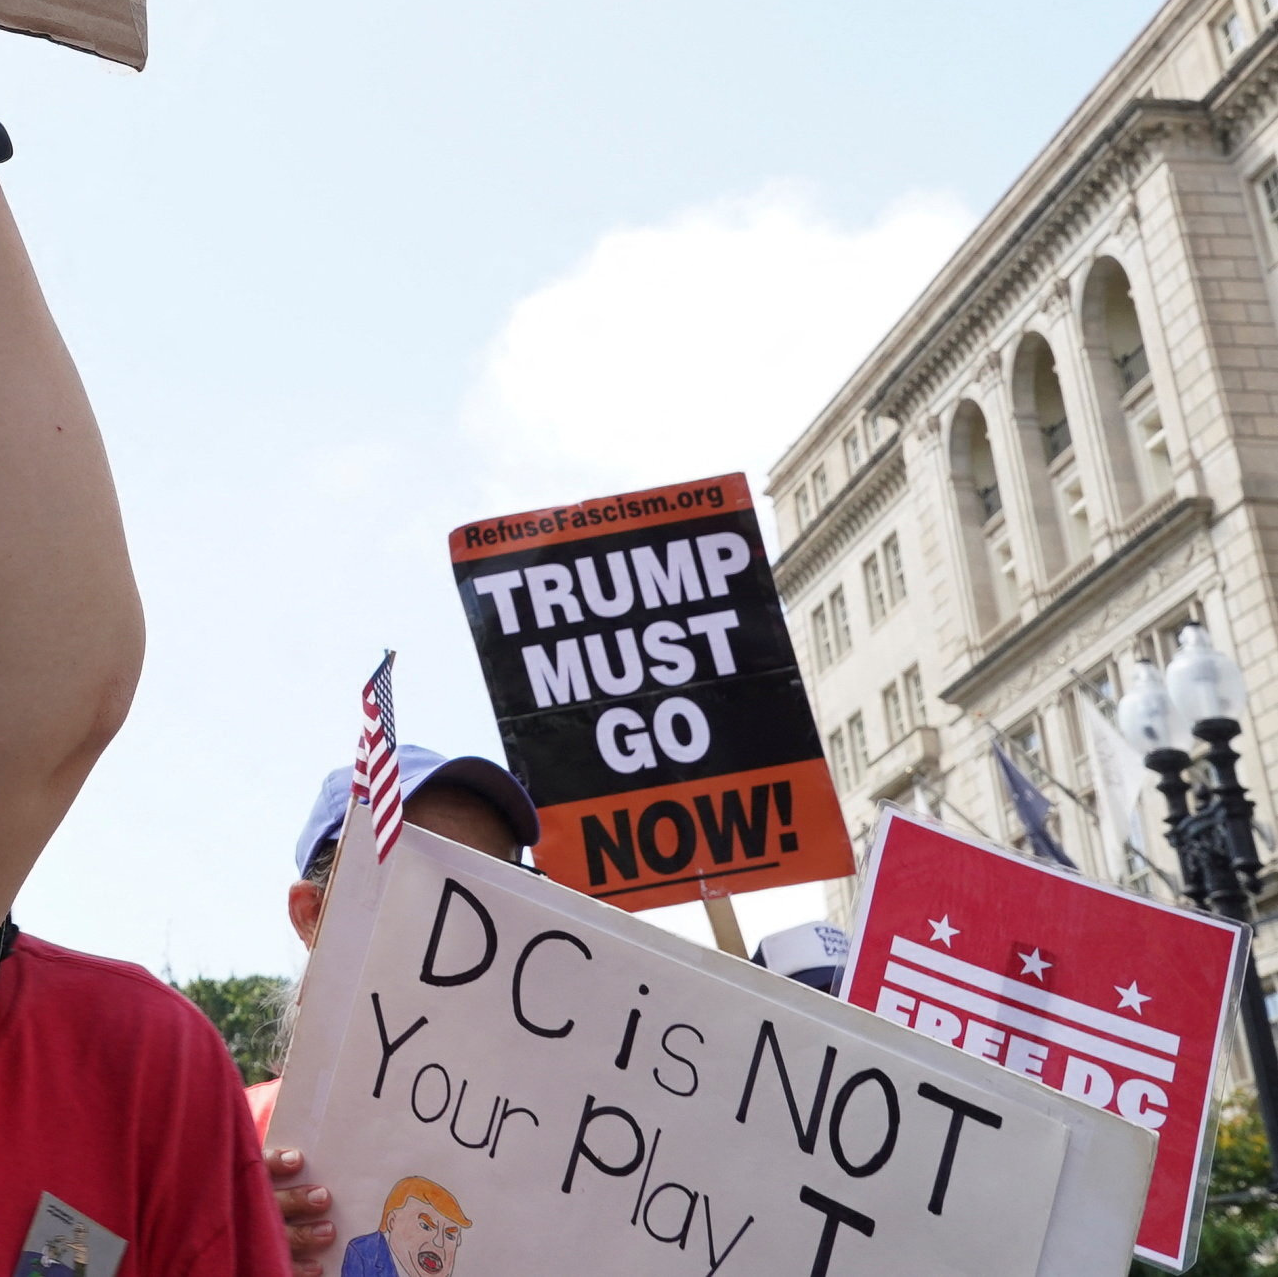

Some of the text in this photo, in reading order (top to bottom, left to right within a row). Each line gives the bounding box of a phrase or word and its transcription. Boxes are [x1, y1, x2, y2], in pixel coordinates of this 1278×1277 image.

[464, 483, 725, 549] RefuseFascism.org
[473, 531, 751, 636] TRUMP
[522, 609, 740, 709] MUST
[596, 696, 711, 775] GO
[581, 780, 799, 887] NOW!
[371, 992, 539, 1159] Your
[420, 877, 1003, 1216] DC is NOT
[875, 985, 1170, 1130] FREE DC
